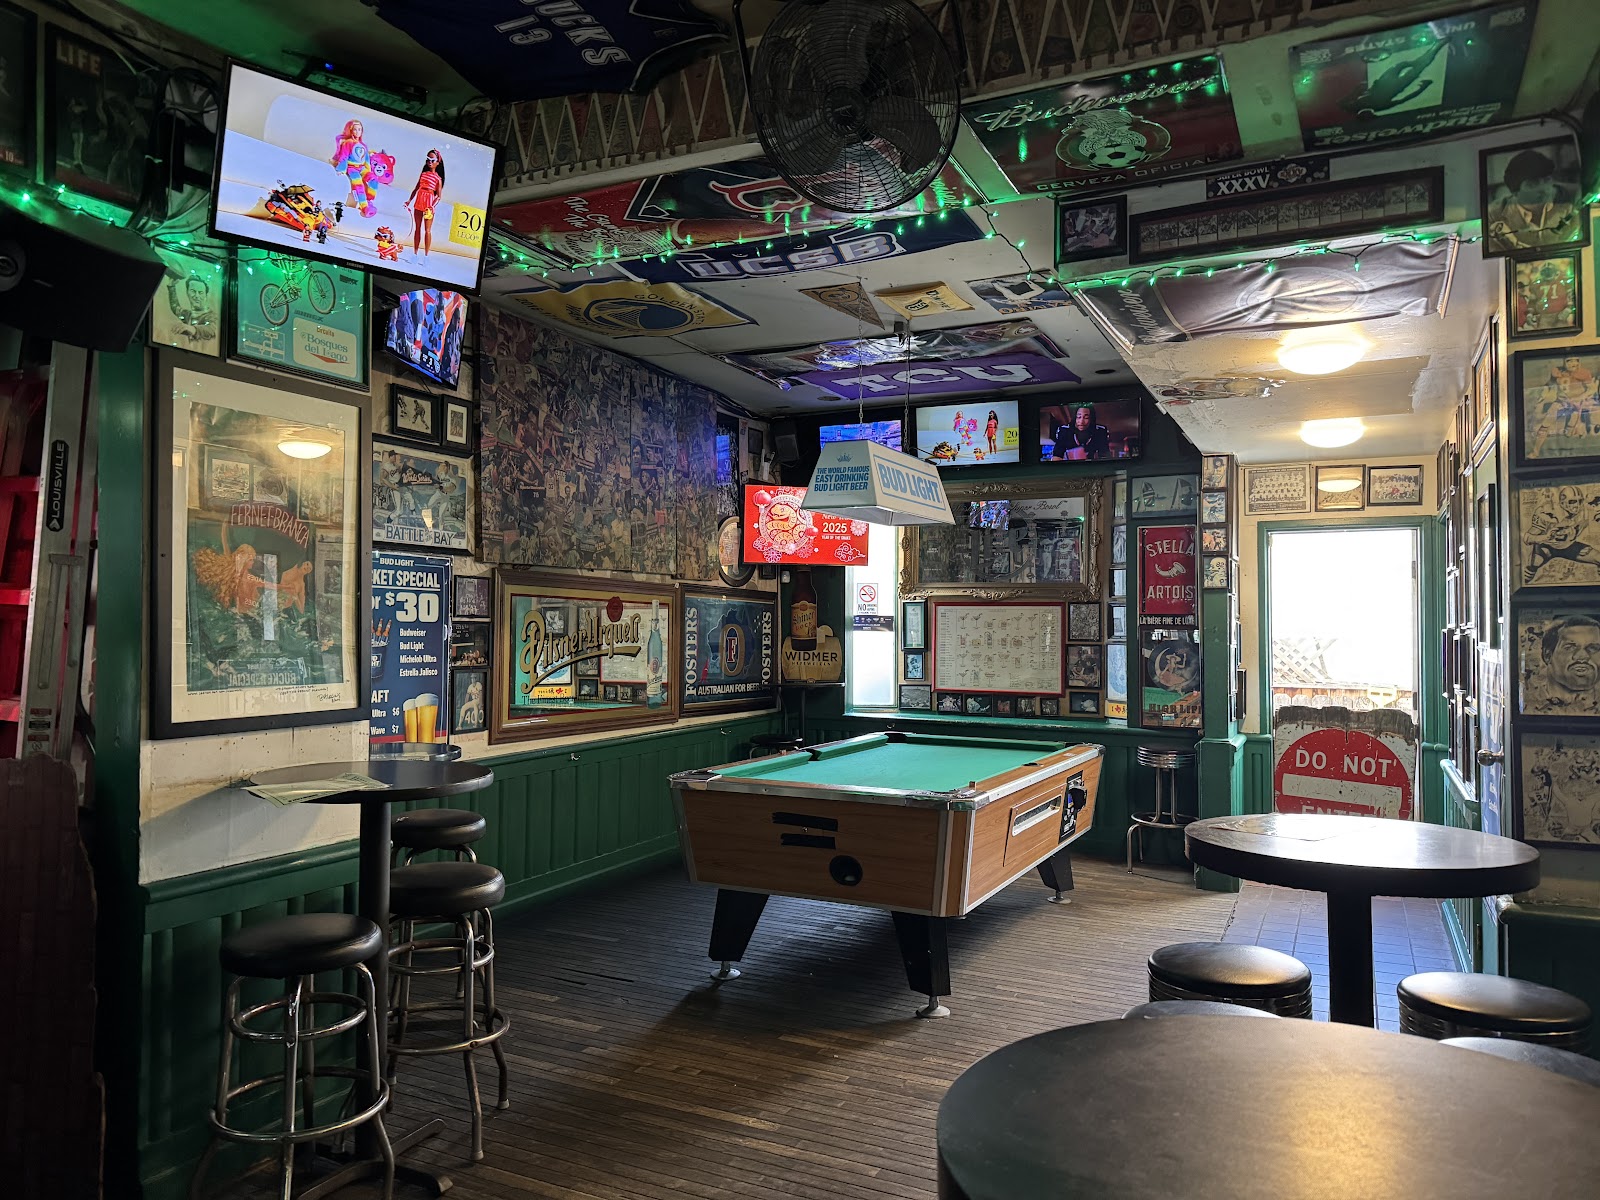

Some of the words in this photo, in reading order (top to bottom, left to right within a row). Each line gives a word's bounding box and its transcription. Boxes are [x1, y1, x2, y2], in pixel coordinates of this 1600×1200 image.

[494, 15, 553, 45] 13
[520, 0, 632, 66] UCKS
[56, 38, 102, 76] LIFE
[975, 74, 1219, 131] Budweiser
[1313, 113, 1493, 147] Budweiser
[1036, 174, 1127, 191] CERVEZA
[1134, 156, 1219, 176] OFICIAL
[1216, 174, 1270, 196] XXXV
[691, 234, 898, 278] UCSB
[1540, 284, 1559, 300] 71
[634, 294, 695, 312] GOLDEN
[1117, 288, 1174, 344] Budweiser
[304, 343, 320, 356] del
[307, 333, 348, 353] Bosques
[831, 364, 1033, 394] TCU
[815, 475, 834, 484] EASY
[834, 473, 869, 483] DRINKING
[817, 467, 827, 475] THE
[847, 465, 870, 474] FAMOUS
[52, 441, 66, 520] LOUISVILLE
[814, 483, 828, 492] BUD
[828, 482, 850, 492] LIGHT
[850, 481, 868, 491] BEER
[878, 463, 908, 494] BUD
[906, 474, 942, 504] LIGHT
[386, 525, 424, 542] BATTLE
[434, 531, 455, 546] BAY
[823, 522, 848, 534] 2025
[1146, 539, 1195, 557] STELLA
[380, 557, 394, 565] BUD
[395, 558, 414, 567] LIGHT
[372, 569, 394, 585] KET
[396, 570, 440, 588] SPECIAL
[1146, 585, 1196, 600] ARTOIS
[858, 603, 866, 611] NO
[1175, 616, 1182, 625] DE
[400, 628, 426, 637] Budweiser
[400, 641, 410, 650] Bud
[411, 642, 424, 651] Light
[520, 609, 588, 694] Pilsner
[584, 609, 642, 659] Urquell
[685, 607, 698, 697] FOSTER'S
[727, 637, 737, 663] F
[400, 655, 422, 663] Michelob
[423, 655, 437, 663] Ultra
[785, 651, 838, 662] WIDMER
[400, 668, 419, 677] Estrella
[419, 667, 438, 677] Jalisco
[371, 690, 389, 703] AFT
[697, 684, 735, 696] AUSTRALIAN
[735, 683, 746, 693] FOR
[371, 709, 386, 718] Ultra
[392, 707, 400, 717] $6
[370, 726, 385, 735] Wave
[392, 724, 399, 734] $7
[1296, 748, 1327, 770] DO
[1343, 754, 1392, 778] NOT
